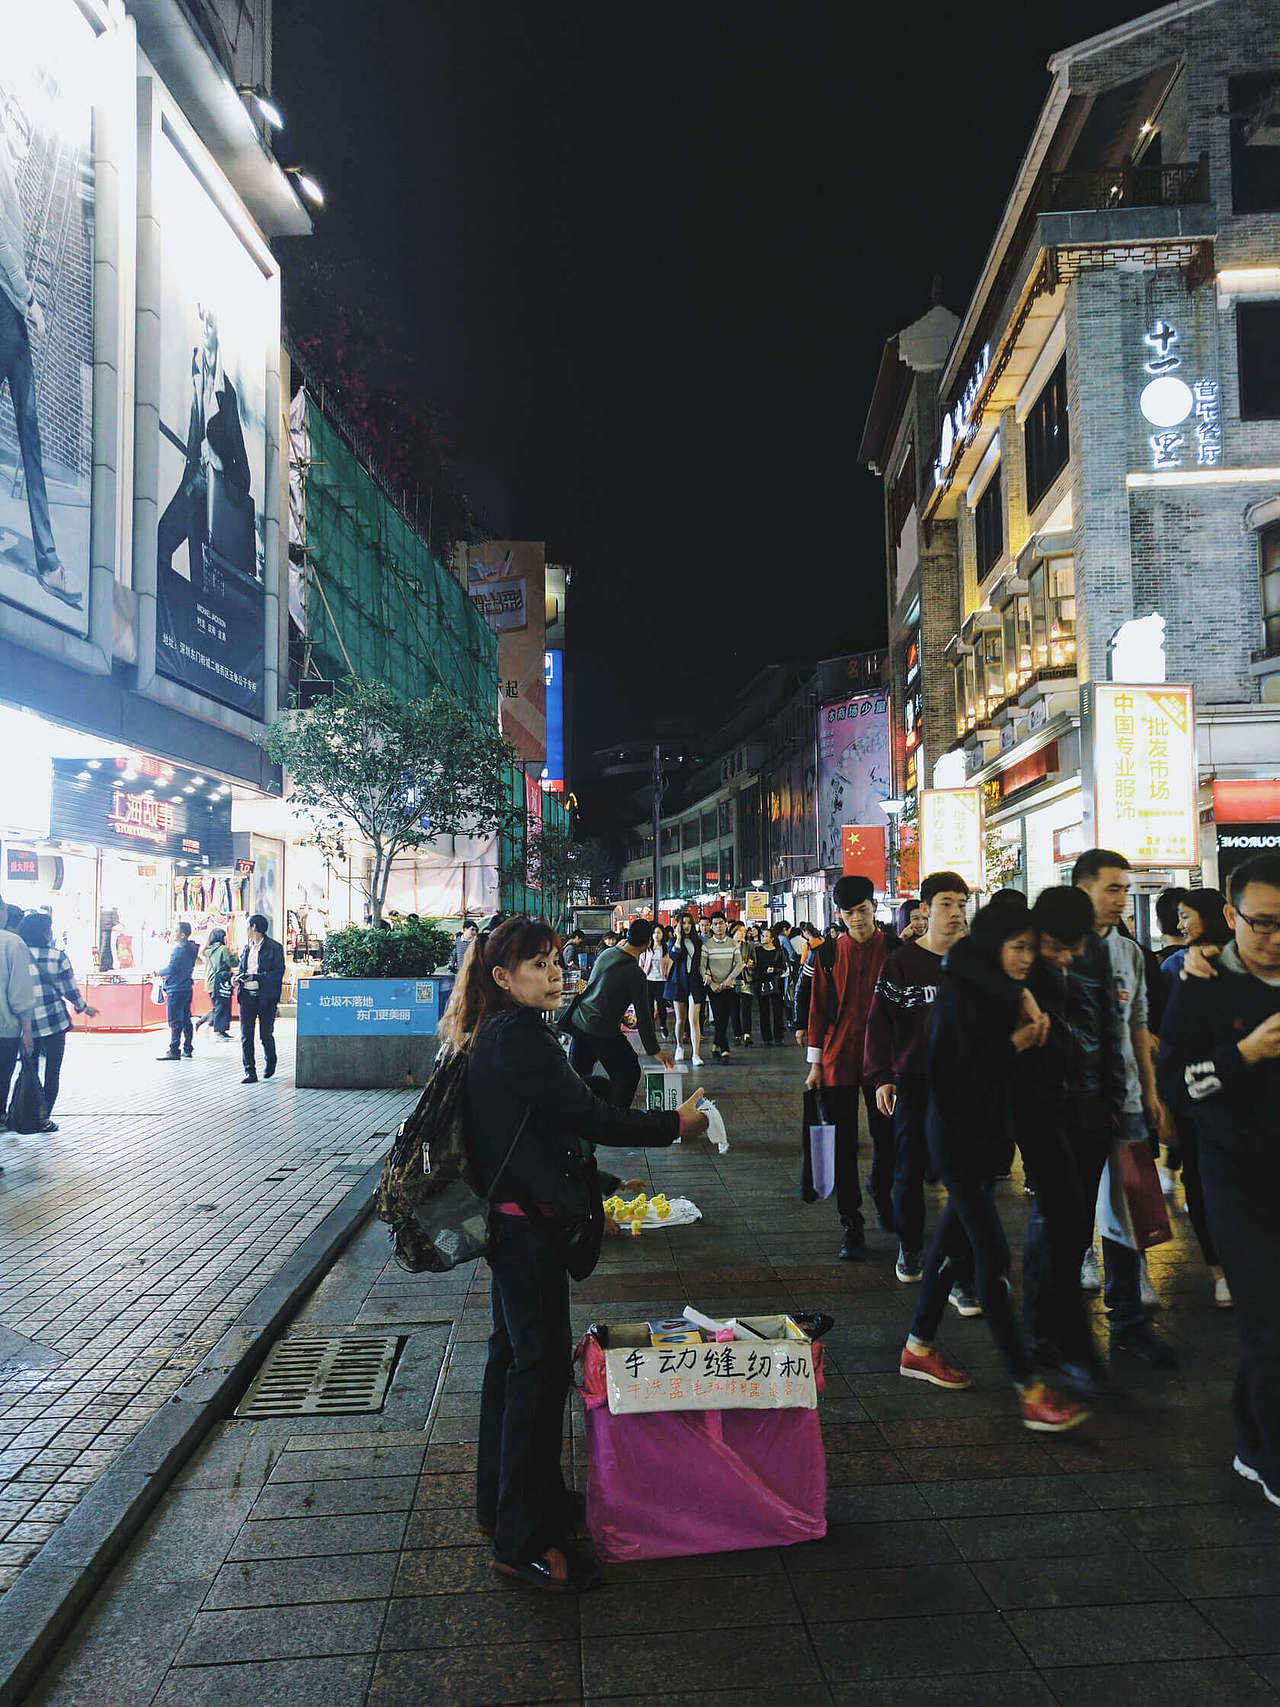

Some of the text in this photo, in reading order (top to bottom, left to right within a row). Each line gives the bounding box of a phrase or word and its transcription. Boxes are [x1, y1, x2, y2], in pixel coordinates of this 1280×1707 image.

[1114, 693, 1136, 819] 中国专业服饰
[1144, 716, 1169, 800] 批发市场
[105, 790, 175, 832] 上海故事
[320, 995, 374, 1008] 垃圾不落地
[356, 1009, 411, 1021] 东门更美丽
[625, 1346, 810, 1380] 手动缝纫机
